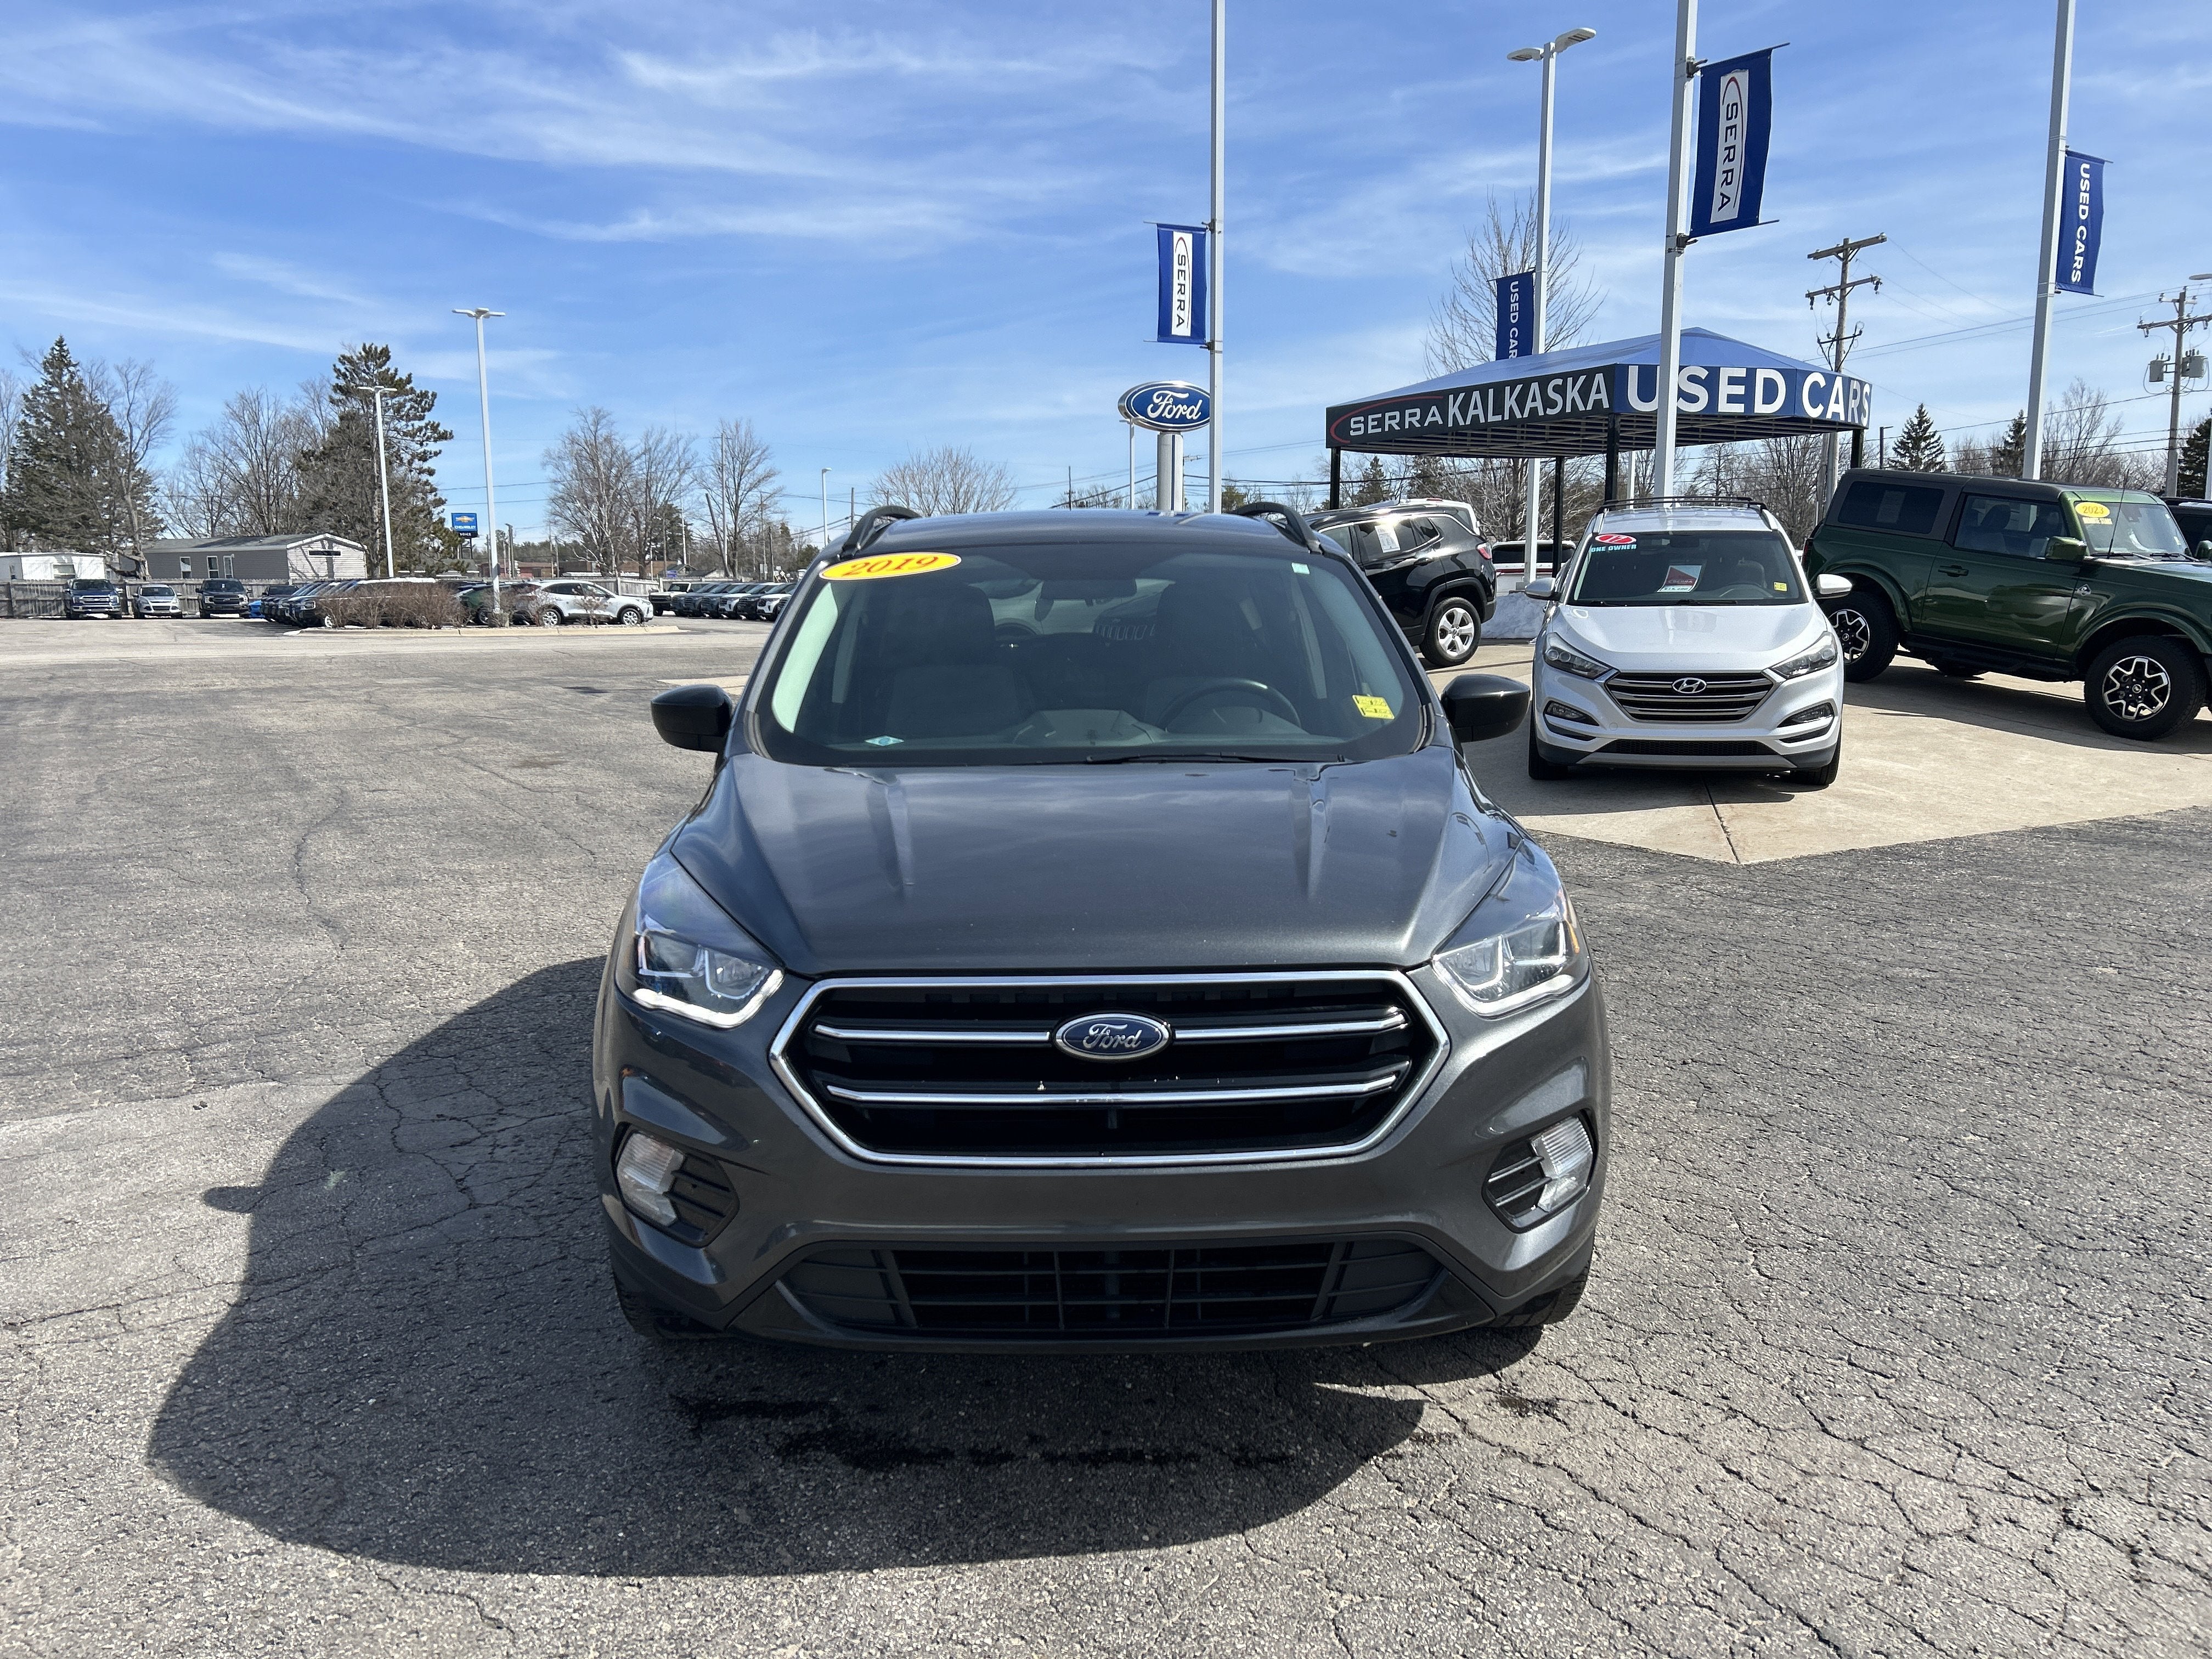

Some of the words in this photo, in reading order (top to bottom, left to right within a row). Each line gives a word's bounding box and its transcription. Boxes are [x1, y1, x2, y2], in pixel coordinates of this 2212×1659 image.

[1717, 101, 1739, 211] SERRA
[2078, 163, 2090, 220] USED
[2071, 225, 2087, 283] CARS
[1176, 253, 1186, 328] SERRA
[1510, 280, 1519, 324] USED
[1147, 390, 1203, 420] Ford
[1350, 405, 1443, 437] SERRA
[1447, 373, 1610, 427] KALKASKA
[1627, 365, 1786, 414] USED
[1802, 371, 1871, 427] CARS
[2081, 505, 2104, 515] 2023
[842, 556, 939, 577] 2019
[1083, 1023, 1142, 1049] Ford
